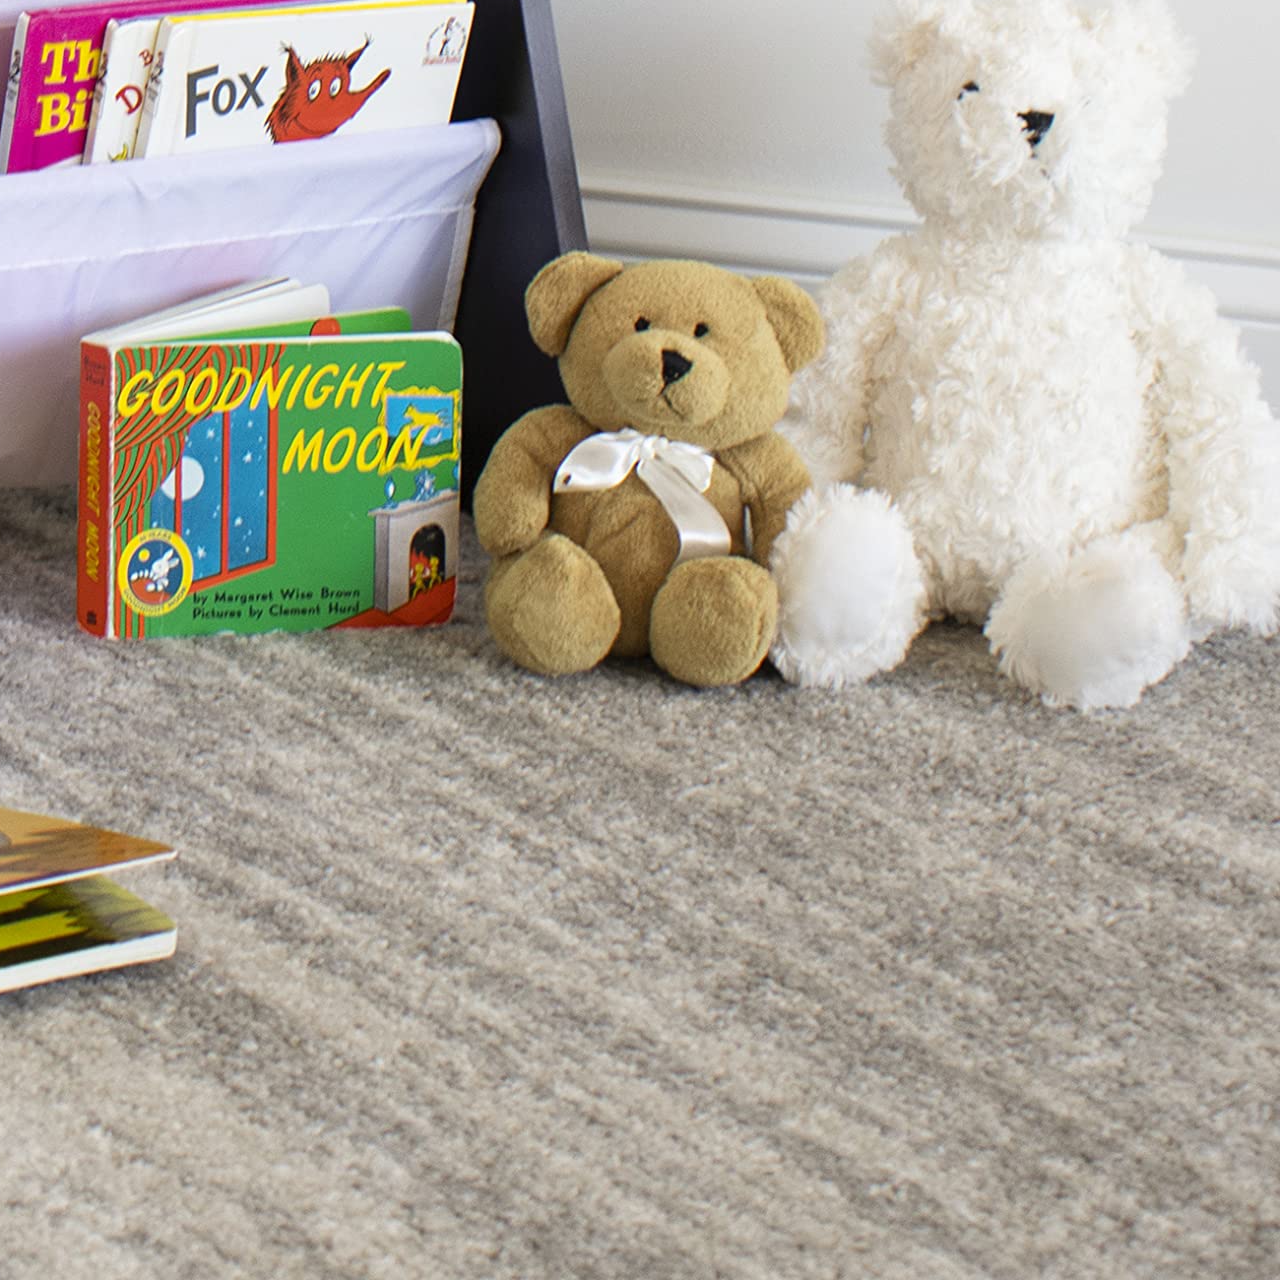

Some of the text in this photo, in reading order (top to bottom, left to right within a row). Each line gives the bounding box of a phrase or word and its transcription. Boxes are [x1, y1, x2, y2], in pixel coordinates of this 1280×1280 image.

[185, 65, 269, 138] Fox
[117, 361, 407, 419] GOODNIGHT
[282, 424, 433, 476] MOON
[192, 601, 360, 620] Pictures by Clement Hurd
[193, 587, 361, 606] by Margaret Wise Brown
